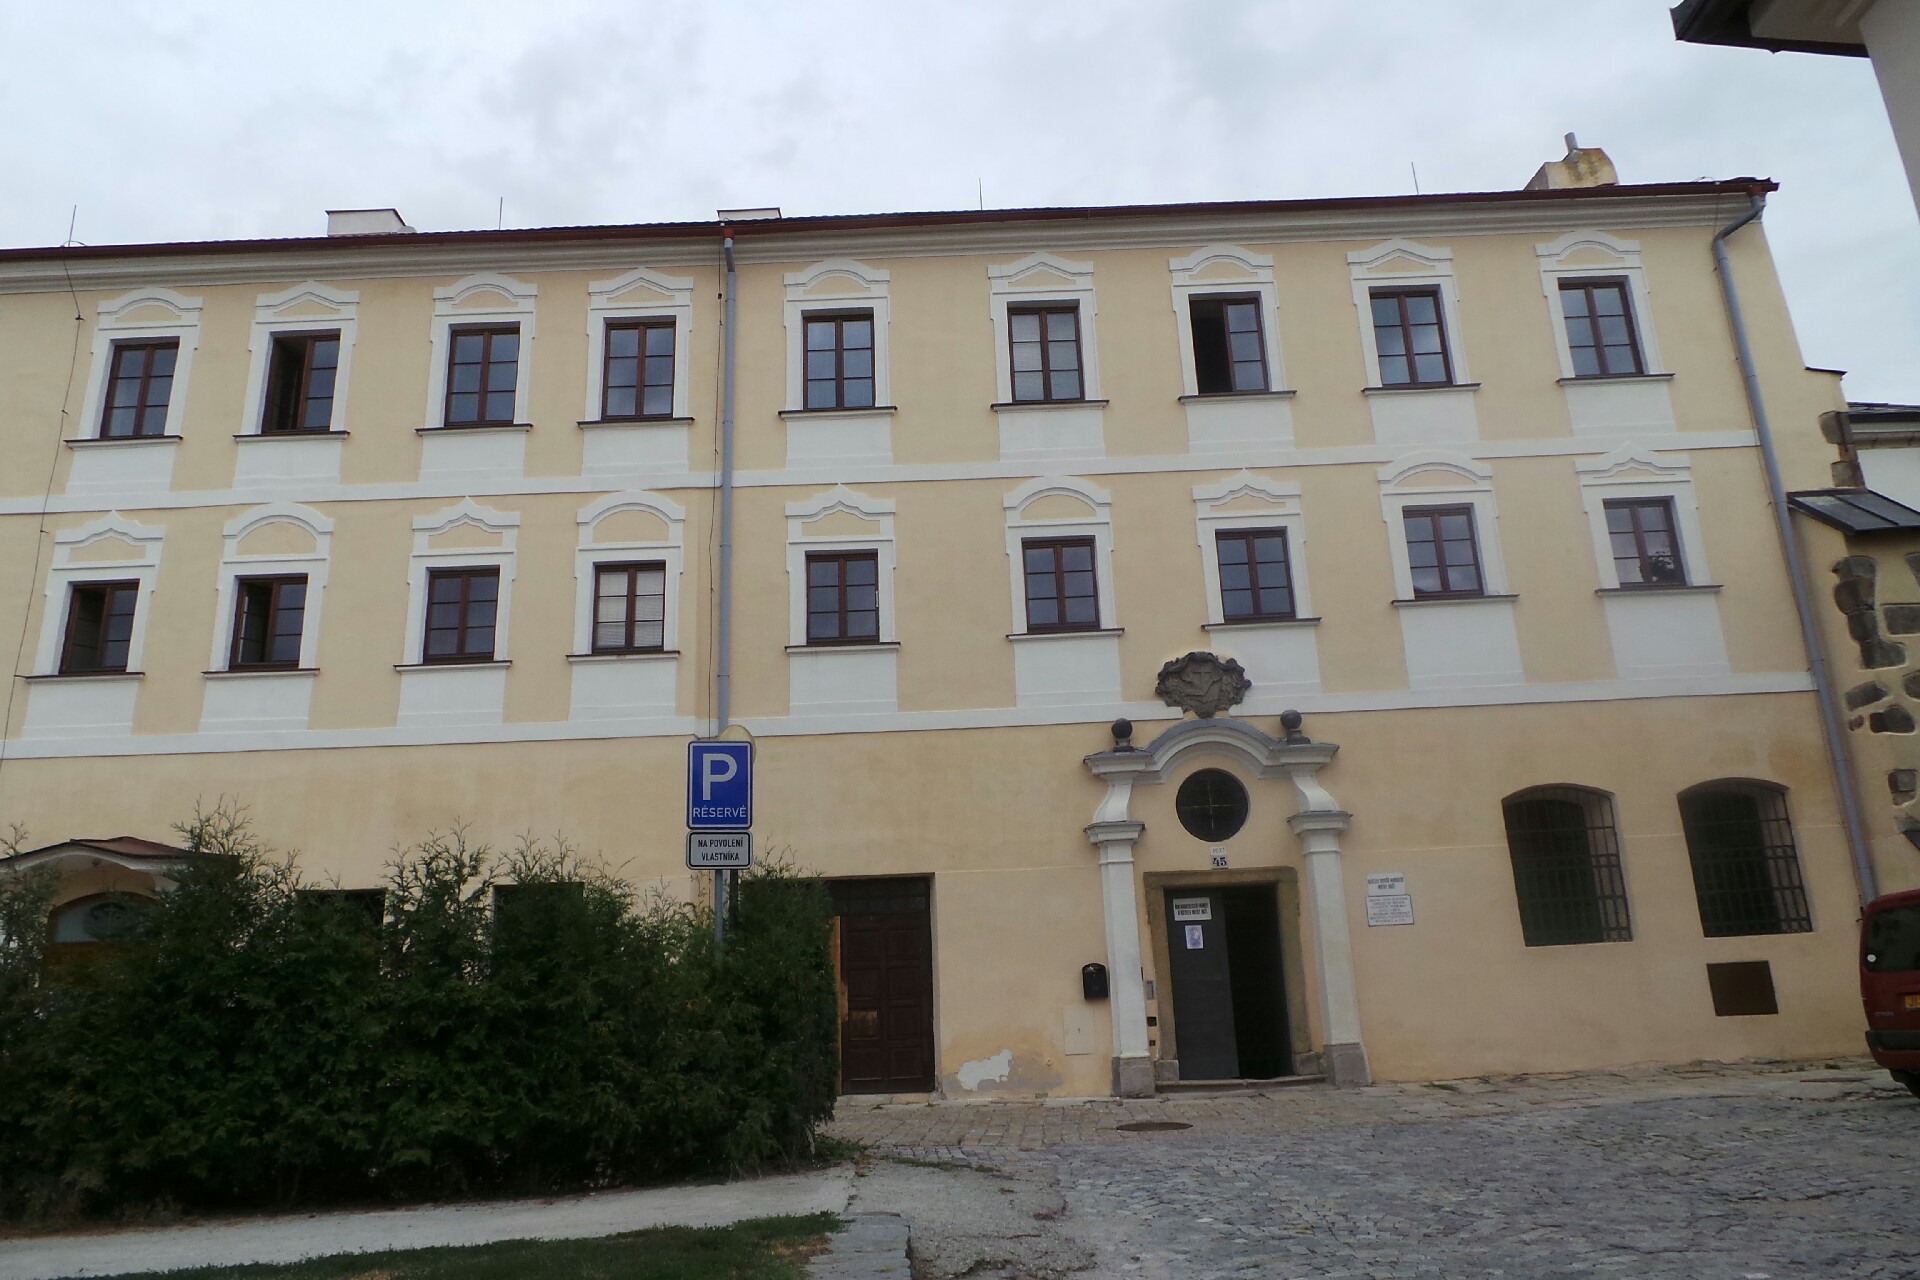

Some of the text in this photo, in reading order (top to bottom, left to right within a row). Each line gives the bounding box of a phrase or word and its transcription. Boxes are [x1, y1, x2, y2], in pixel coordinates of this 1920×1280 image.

[703, 754, 737, 800] P
[693, 804, 747, 817] RÉSERVÉ
[698, 837, 743, 847] NA POVOLENÍ
[702, 850, 740, 861] VLASTNÍKA
[1212, 857, 1227, 867] 45
